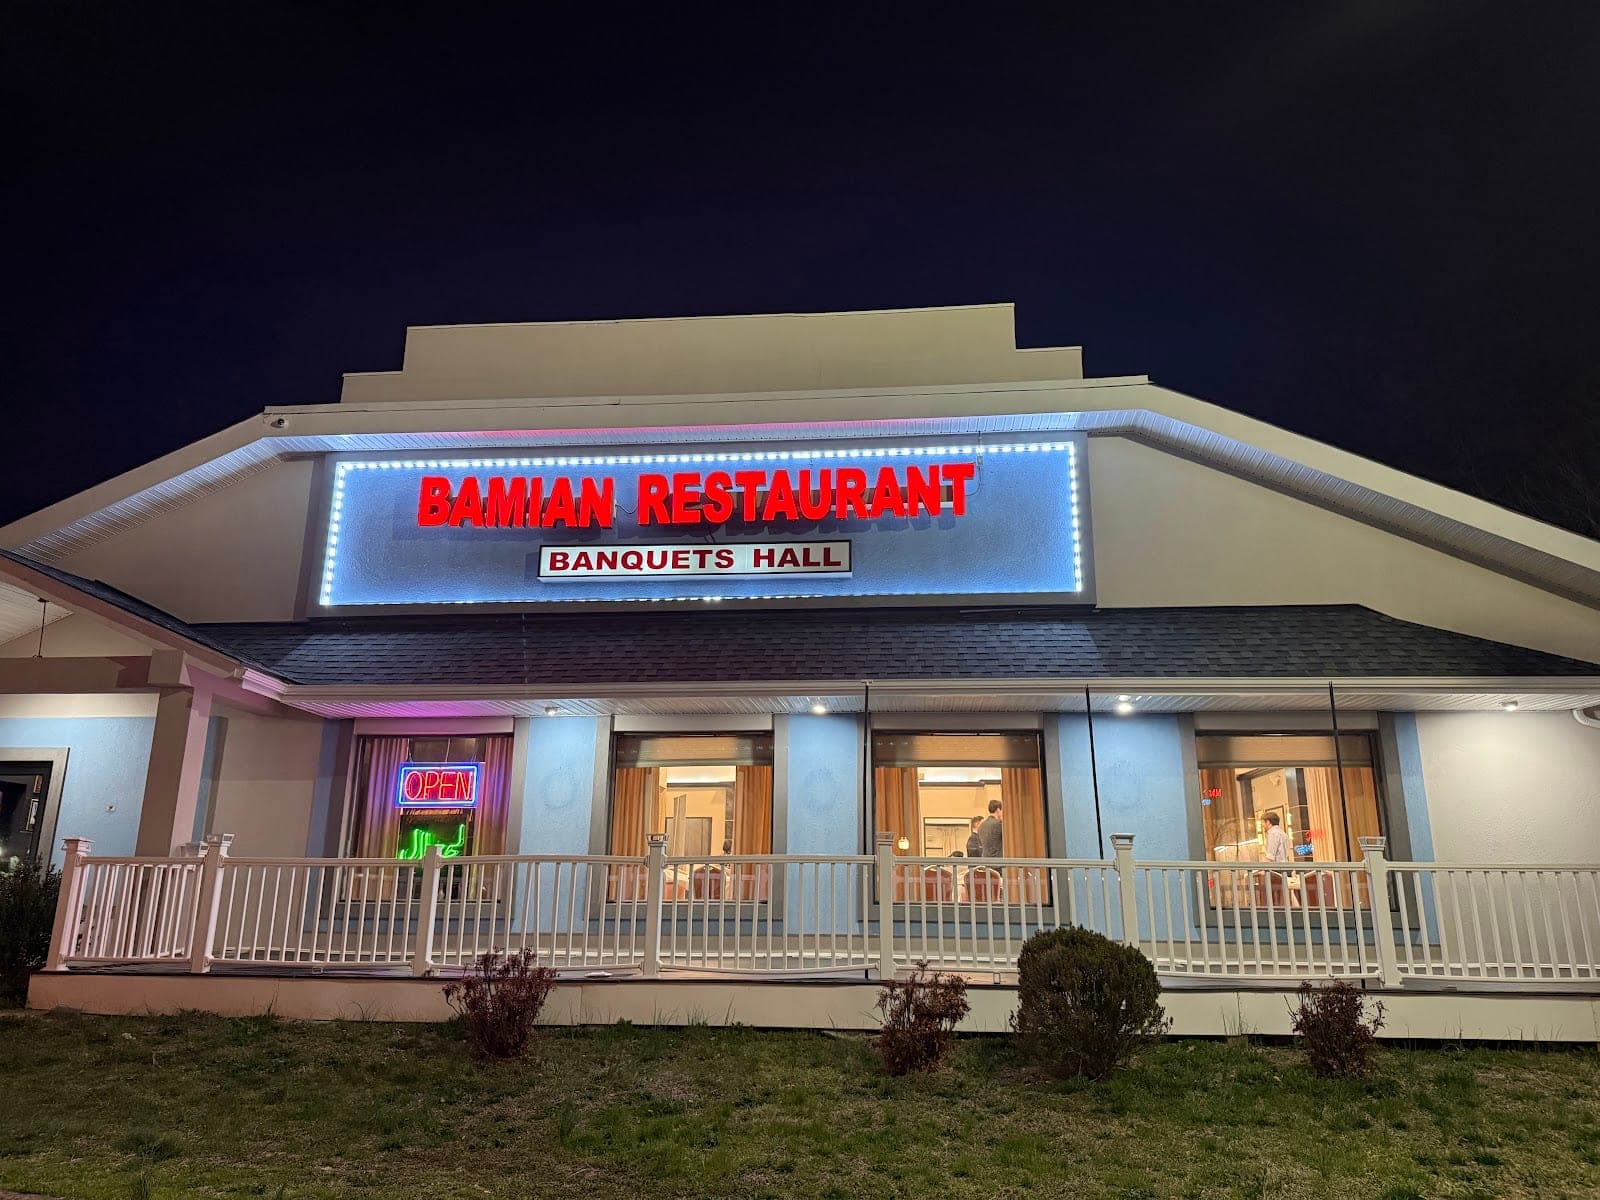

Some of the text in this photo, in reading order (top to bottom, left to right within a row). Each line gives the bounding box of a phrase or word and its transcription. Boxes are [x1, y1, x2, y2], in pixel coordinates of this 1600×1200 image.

[418, 463, 976, 527] BAMIAN RESTAURANT
[549, 547, 842, 572] BANQUETS HALL
[404, 770, 473, 800] OPEN
